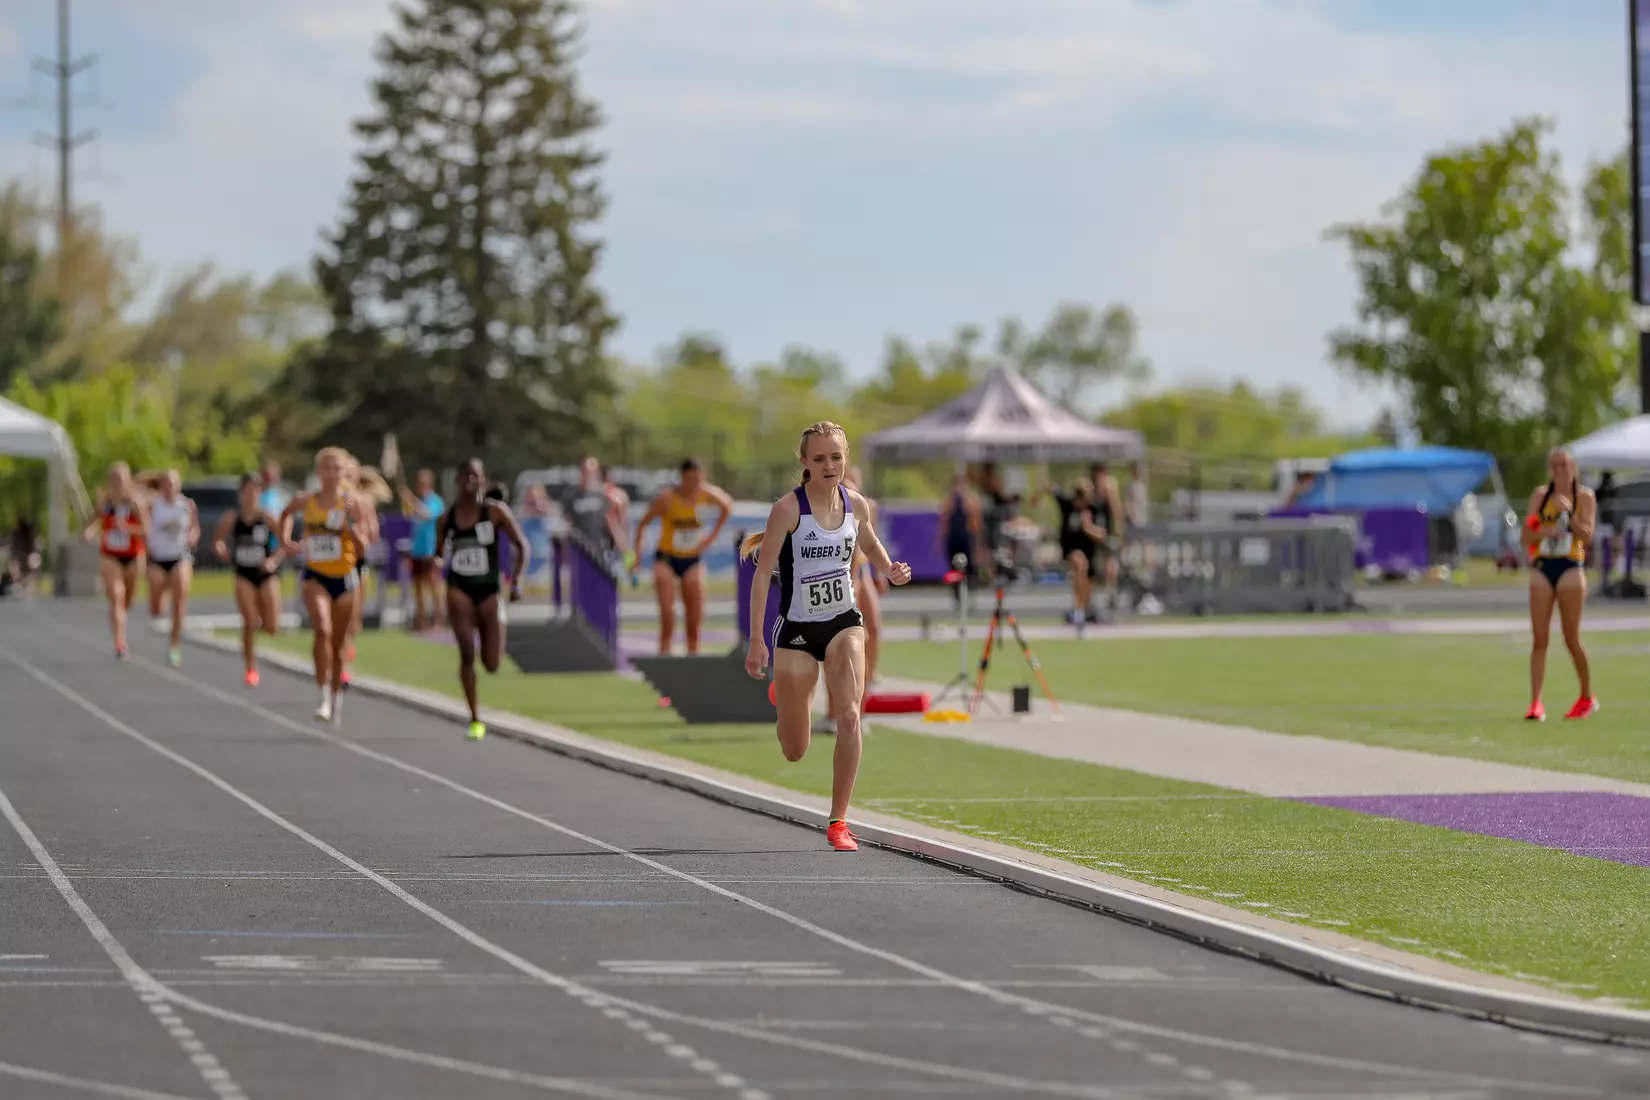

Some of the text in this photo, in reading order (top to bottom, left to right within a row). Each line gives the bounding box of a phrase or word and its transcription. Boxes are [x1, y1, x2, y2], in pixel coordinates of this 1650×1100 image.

[801, 545, 834, 558] WEBER
[841, 537, 852, 562] 5
[809, 578, 844, 606] 536
